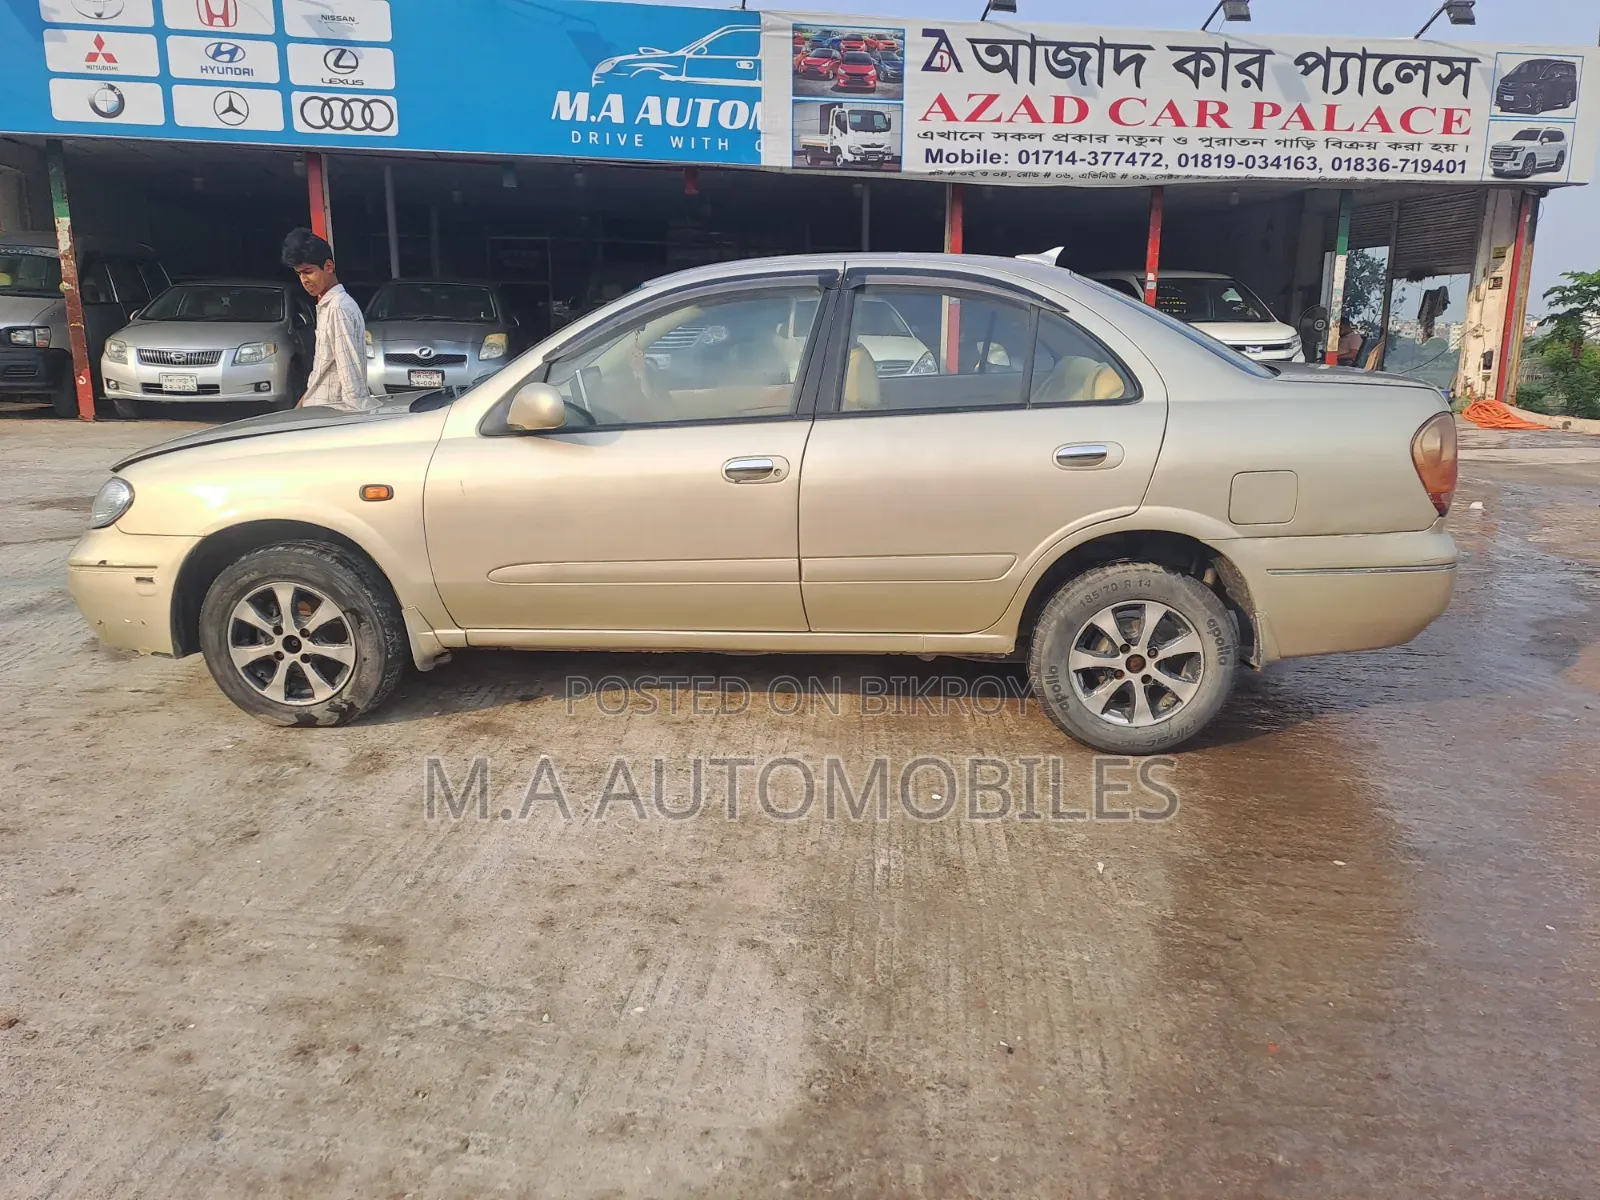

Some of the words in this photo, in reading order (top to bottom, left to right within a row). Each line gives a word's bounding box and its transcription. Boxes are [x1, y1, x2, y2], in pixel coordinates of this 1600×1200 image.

[321, 14, 356, 23] NISSAN
[200, 65, 254, 77] HYUNDAI
[966, 33, 1155, 89] আজাদ
[1166, 41, 1275, 93] কার
[1294, 46, 1481, 100] প্যালেস
[321, 77, 364, 86] LEXUS
[551, 90, 624, 125] M.A
[918, 92, 1089, 125] AZAD
[1108, 97, 1233, 130] CAR
[1248, 102, 1472, 136] PALACE
[571, 130, 644, 148] DRIVE
[670, 135, 729, 152] WITH
[917, 130, 985, 142] এখানে
[991, 132, 1046, 143] সকল
[1052, 133, 1109, 145] প্রকার
[1115, 134, 1165, 148] নতুন
[1173, 136, 1188, 145] ও
[1198, 136, 1267, 149] পুরাতন
[1274, 136, 1318, 151] গাড়ি
[1325, 137, 1380, 152] বিক্রয়
[1385, 141, 1423, 152] করা
[924, 147, 1010, 165] Mobile:
[1017, 150, 1169, 169] 01714-377472,
[1177, 152, 1323, 174] 01819-034163,
[1331, 156, 1466, 175] 01836-719401
[1206, 617, 1228, 667] apollo
[1045, 664, 1070, 712] apollo
